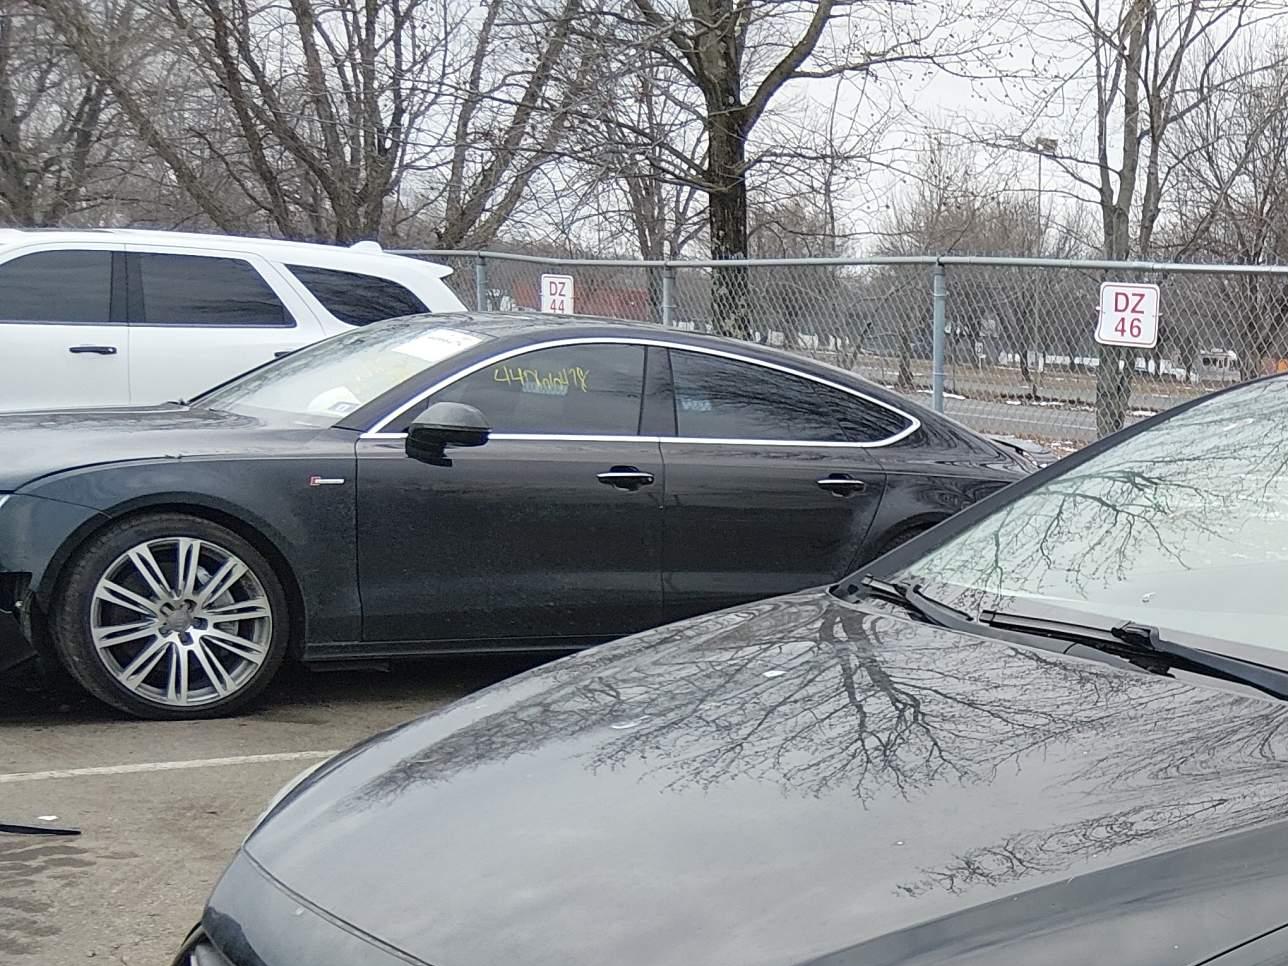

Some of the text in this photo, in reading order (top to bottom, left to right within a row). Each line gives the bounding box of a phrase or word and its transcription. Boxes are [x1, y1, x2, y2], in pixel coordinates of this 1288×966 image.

[549, 281, 566, 297] DZ
[550, 298, 565, 314] 44
[1114, 291, 1146, 314] DZ
[1114, 317, 1142, 338] 46
